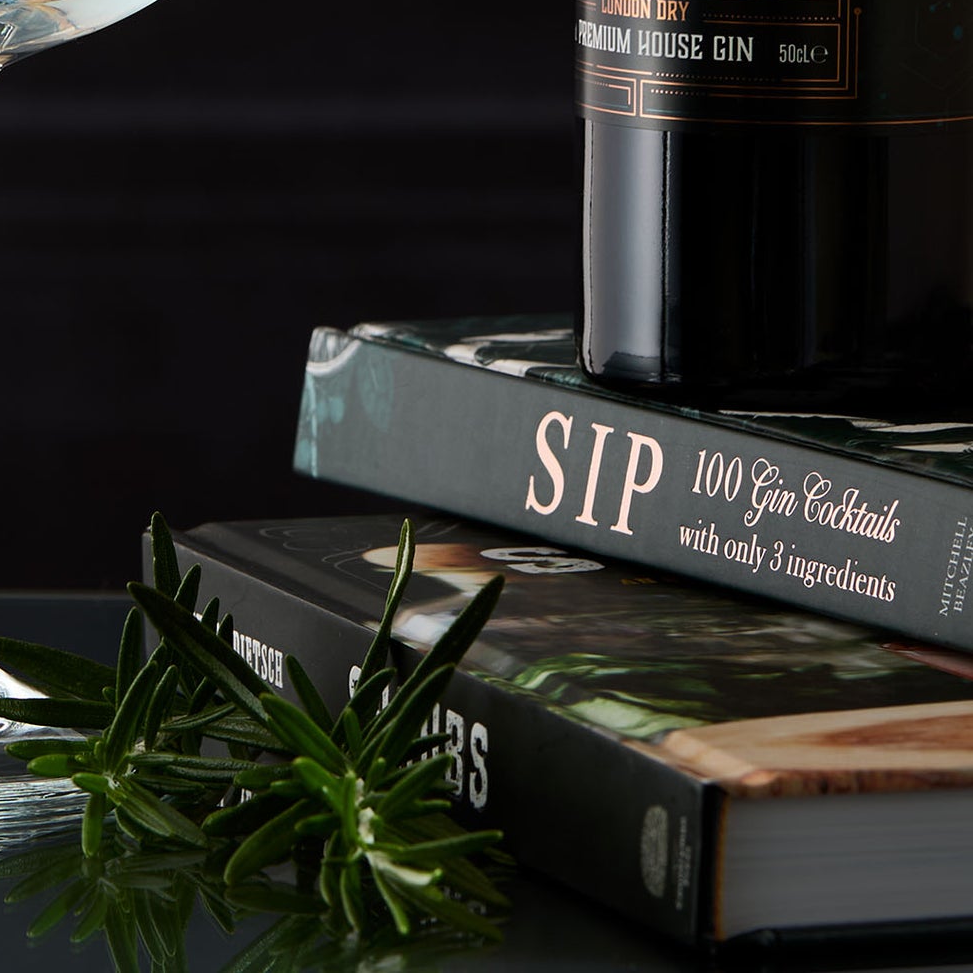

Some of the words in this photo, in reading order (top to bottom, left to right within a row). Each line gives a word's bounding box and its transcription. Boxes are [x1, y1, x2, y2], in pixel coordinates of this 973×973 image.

[578, 19, 631, 54] PREMIUM
[638, 30, 703, 60] HOUSE
[713, 35, 754, 63] GIN
[656, 0, 689, 22] DRY
[525, 410, 664, 536] SIP
[692, 449, 743, 502] 100
[744, 458, 798, 527] Gin
[803, 471, 901, 543] Cocktails
[679, 519, 720, 556] with
[723, 533, 767, 573] only
[769, 540, 784, 571] 3
[786, 543, 896, 602] ingredients
[939, 517, 967, 616] MITCHELL
